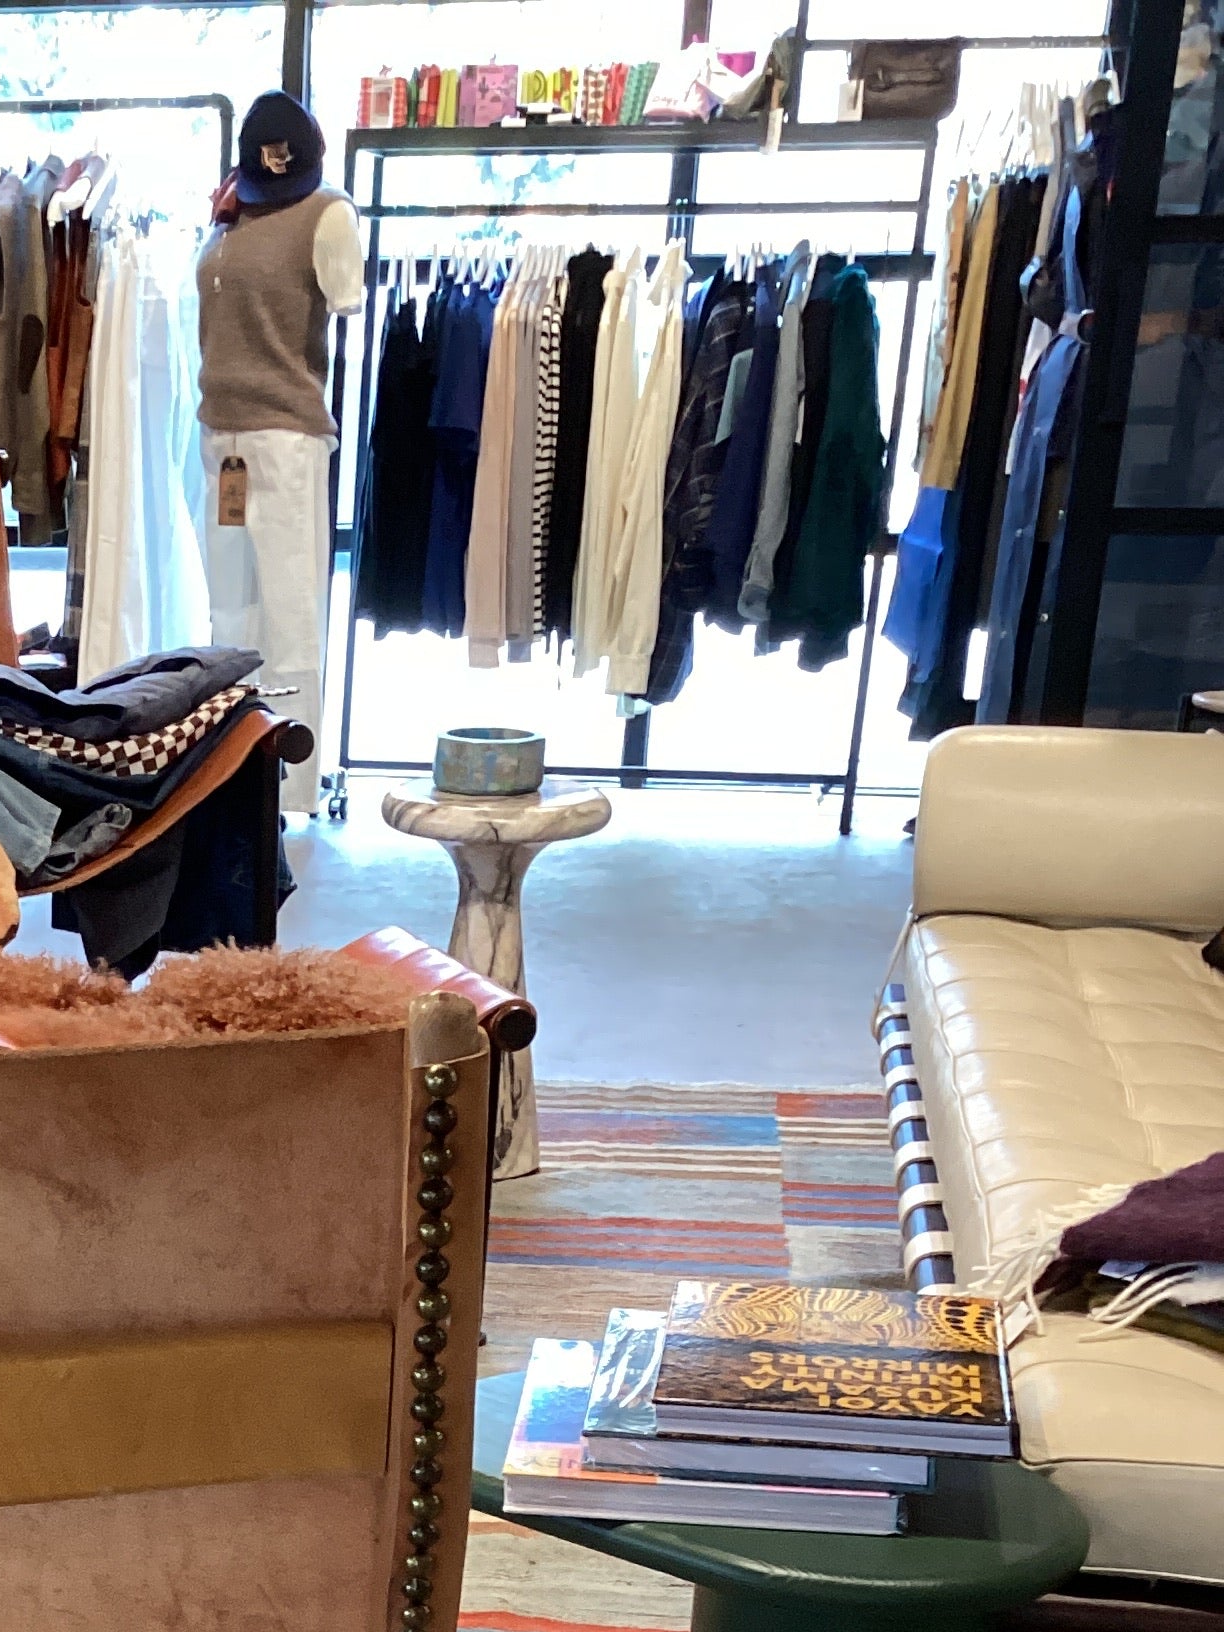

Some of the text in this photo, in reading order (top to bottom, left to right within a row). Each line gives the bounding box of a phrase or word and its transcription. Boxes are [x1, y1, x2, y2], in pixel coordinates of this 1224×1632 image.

[749, 1351, 981, 1377] MIRRORS
[752, 1364, 981, 1388] INFINITY
[739, 1376, 983, 1404] KUSAMA
[818, 1394, 985, 1417] YAYOI
